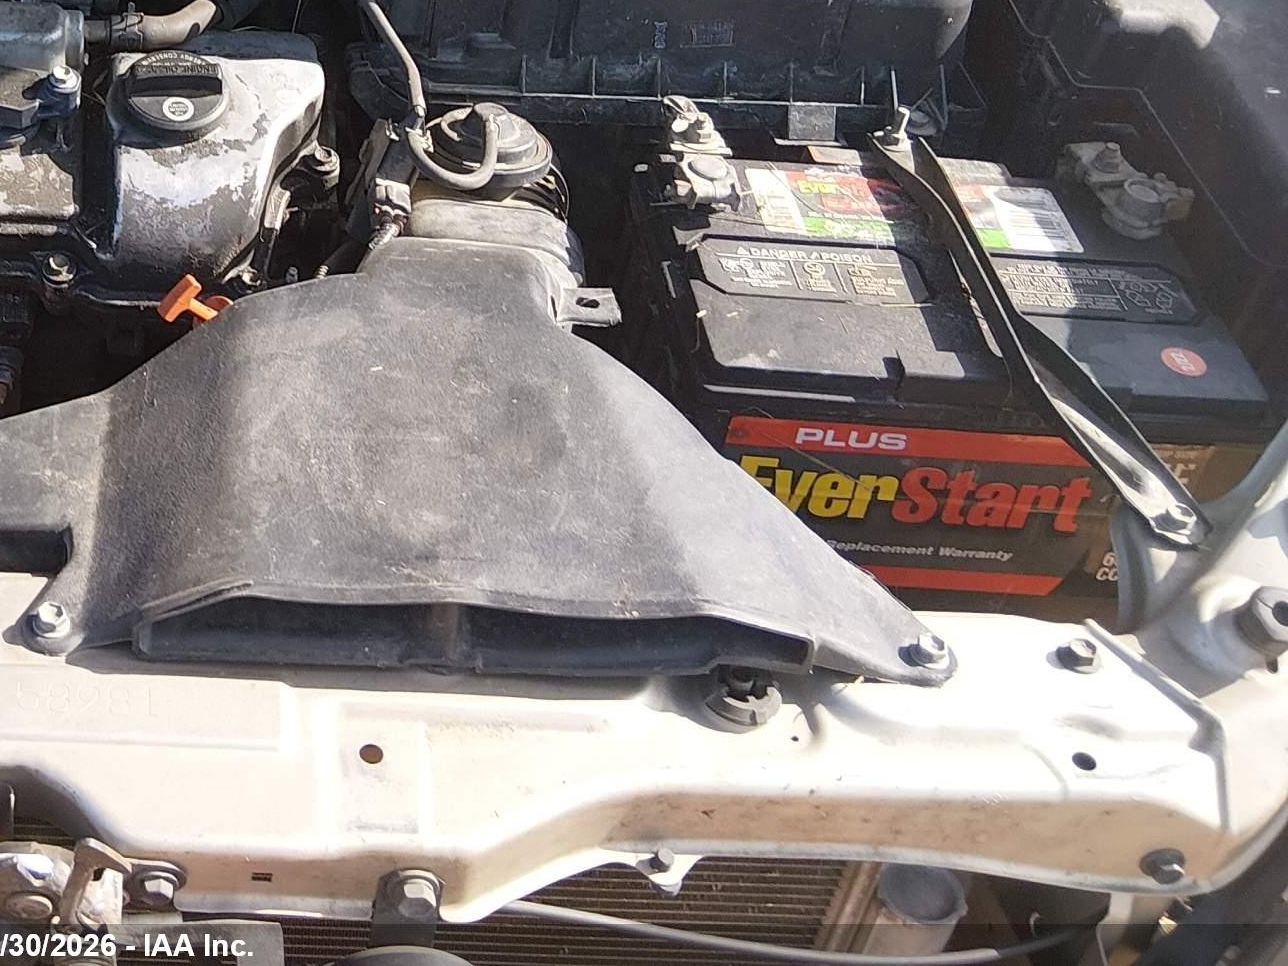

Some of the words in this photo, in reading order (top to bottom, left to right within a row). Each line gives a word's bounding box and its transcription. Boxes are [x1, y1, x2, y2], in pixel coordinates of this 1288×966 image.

[749, 246, 809, 260] DANGER
[795, 428, 907, 450] PLUS
[740, 455, 1093, 532] EverStart
[826, 539, 934, 556] Replacement
[938, 546, 1013, 562] Warranty
